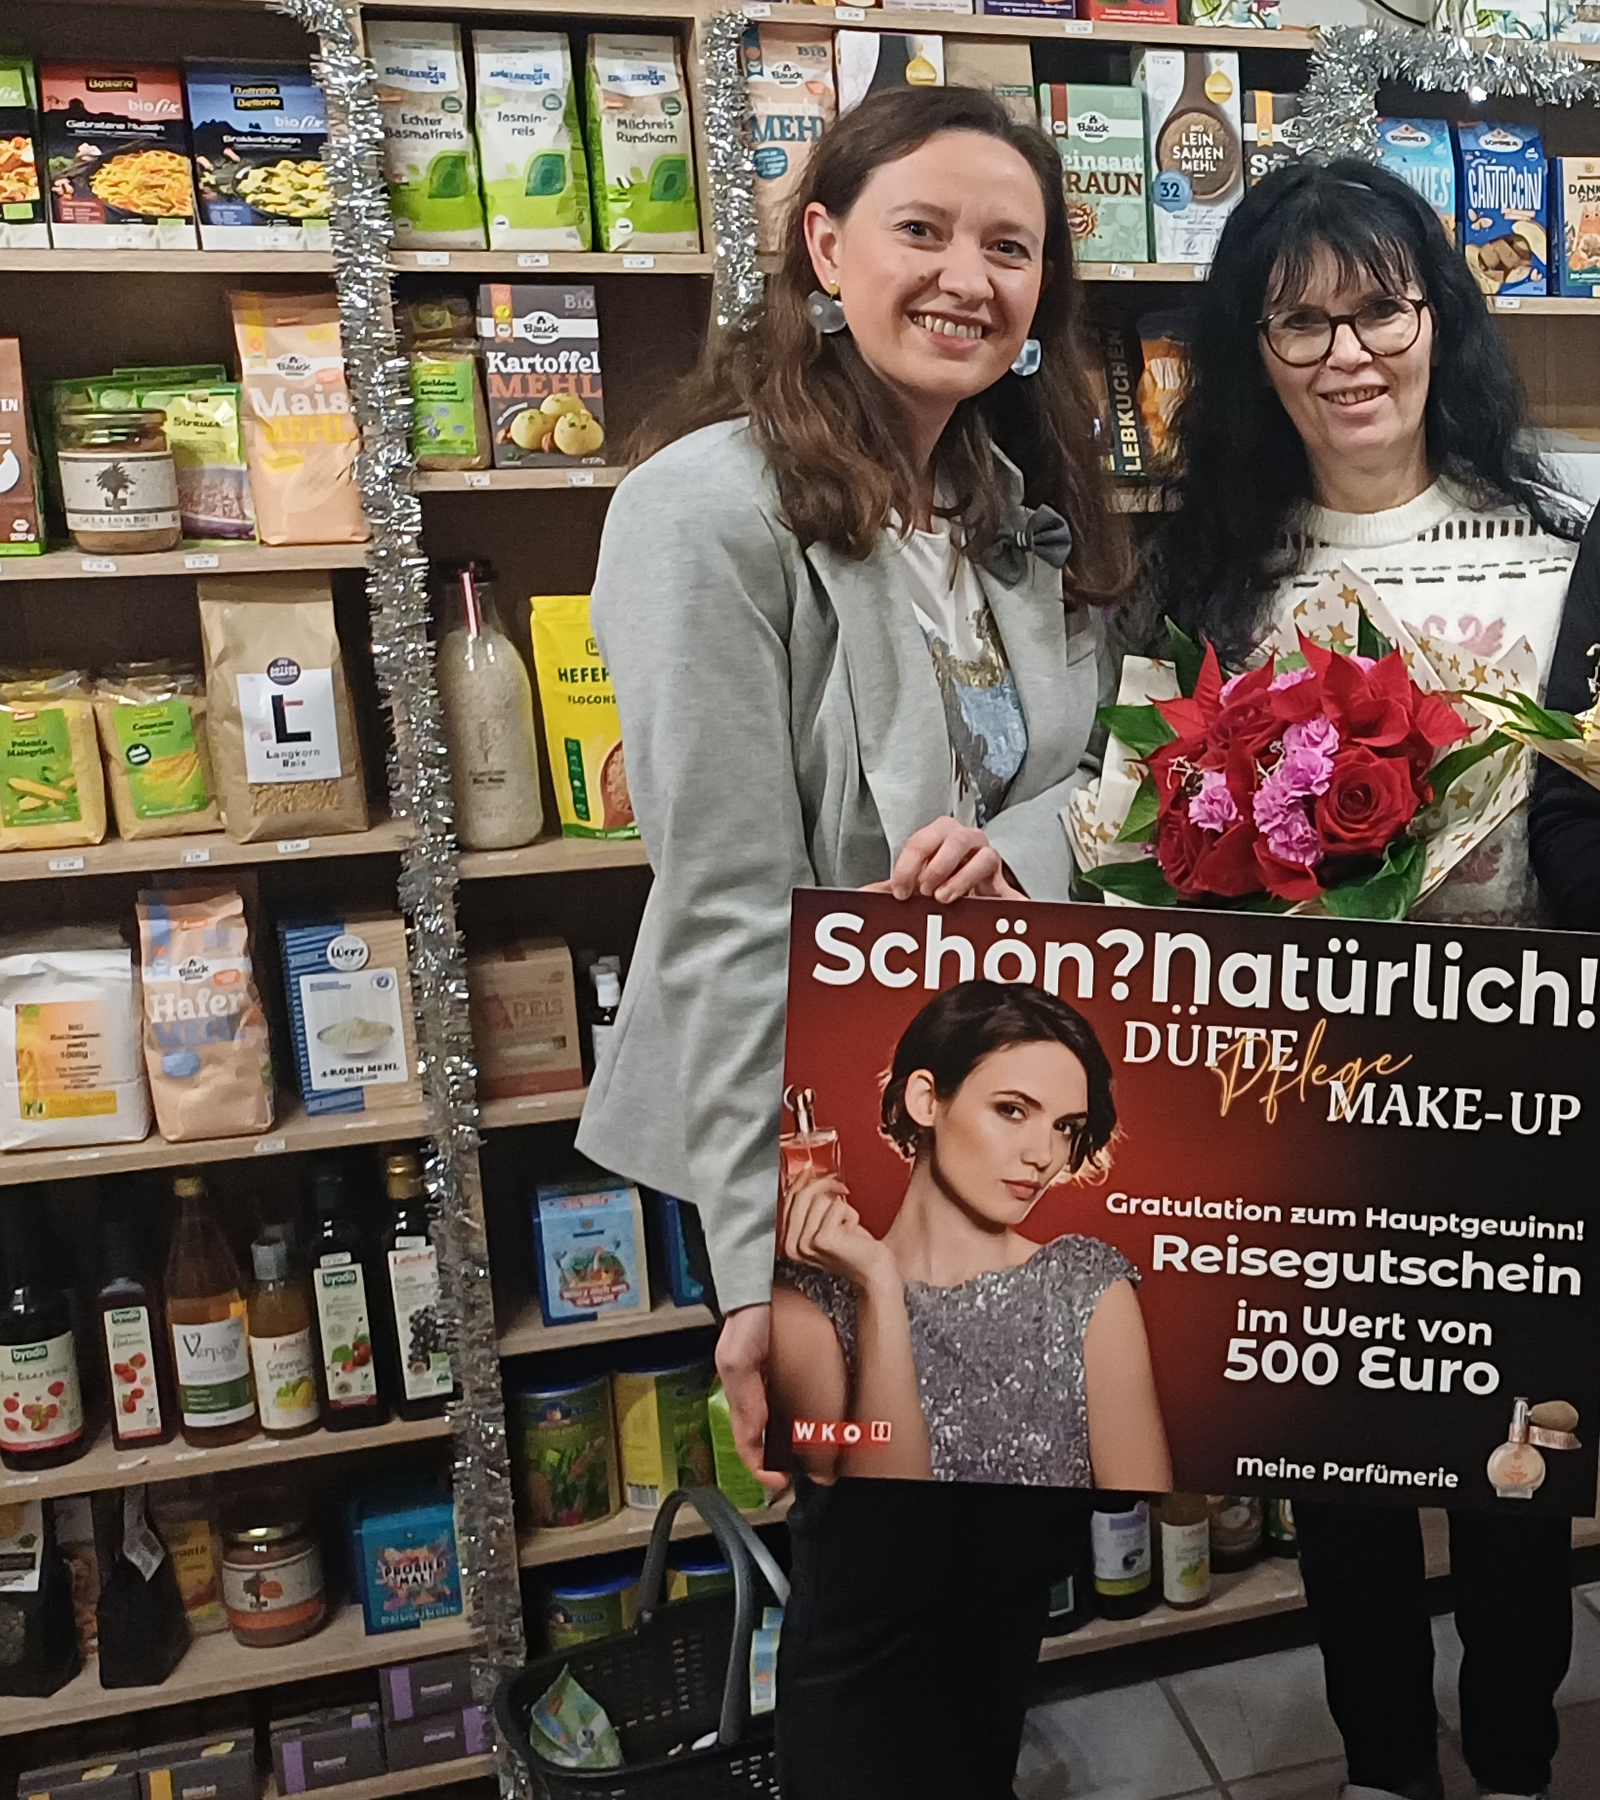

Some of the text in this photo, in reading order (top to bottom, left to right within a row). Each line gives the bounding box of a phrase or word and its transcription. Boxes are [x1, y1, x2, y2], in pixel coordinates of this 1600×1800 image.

[401, 114, 443, 127] Echter
[511, 126, 535, 138] reis
[616, 118, 675, 131] Milchreis
[749, 114, 826, 143] MEH
[1077, 122, 1110, 135] Bauck
[616, 131, 678, 145] Rundkorn
[1181, 132, 1214, 147] LEIN
[1063, 149, 1142, 172] einsaat
[1172, 145, 1224, 160] SAMEN
[1181, 159, 1217, 173] MEHL
[1066, 171, 1143, 197] RAUN
[1160, 181, 1181, 198] 32
[1467, 164, 1542, 212] CANTUCCINI
[522, 322, 560, 335] Bauck
[486, 351, 601, 374] Kartoffel
[489, 373, 603, 399] MEHL
[249, 385, 349, 417] Mais
[1109, 330, 1143, 472] LEBKUCHEN
[150, 989, 245, 1024] Hafer
[1123, 1004, 1299, 1073] DÜFTE
[1210, 1017, 1413, 1125] Pflege
[1326, 1078, 1582, 1137] MAKE-UP
[1105, 1191, 1586, 1242] Gratulation zum Hauptgewinn!
[1151, 1234, 1582, 1297] Reisegutschein
[1236, 1299, 1494, 1347] im Wert von
[12, 1346, 47, 1361] byodo
[1223, 1337, 1501, 1397] 500 Euro
[795, 1421, 862, 1444] WKO
[1236, 1455, 1460, 1489] Meine Parfümerie
